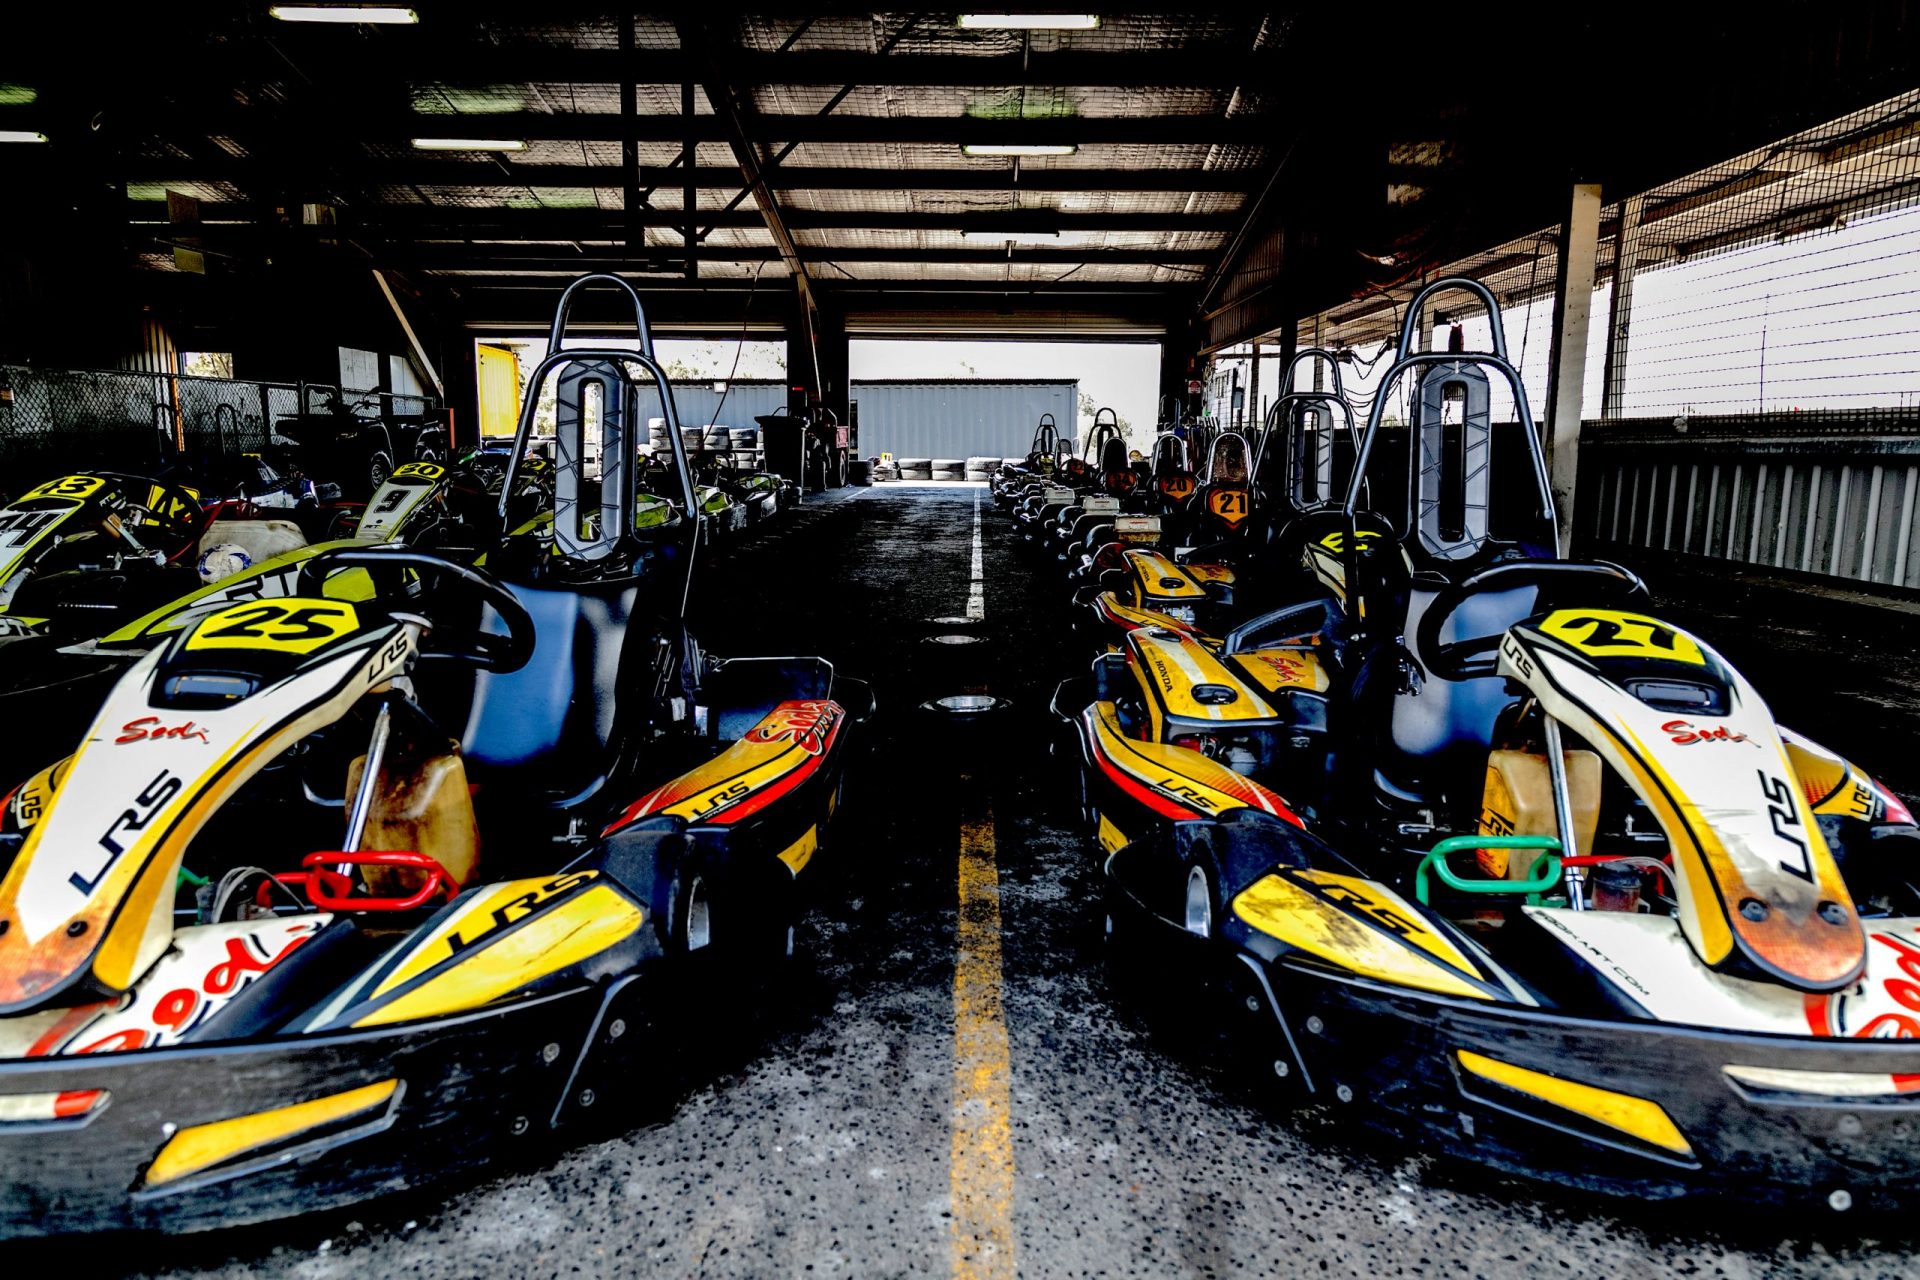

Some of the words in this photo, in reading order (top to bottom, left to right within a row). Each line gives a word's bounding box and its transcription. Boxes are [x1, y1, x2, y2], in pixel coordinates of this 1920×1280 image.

[401, 464, 438, 476] 30
[1166, 479, 1187, 493] 20
[373, 489, 411, 513] 9
[1220, 493, 1248, 514] 21
[202, 606, 345, 641] 25
[1560, 617, 1677, 650] 27
[368, 631, 408, 683] LRS
[1503, 636, 1534, 679] LRS
[1155, 660, 1173, 693] HONDA
[114, 716, 210, 745] Sodi
[21, 788, 42, 819] LRS
[692, 781, 750, 814] LRS
[1156, 779, 1218, 809] LRS
[68, 769, 182, 897] LRS
[1757, 769, 1816, 884] LRS
[447, 872, 593, 953] LRS
